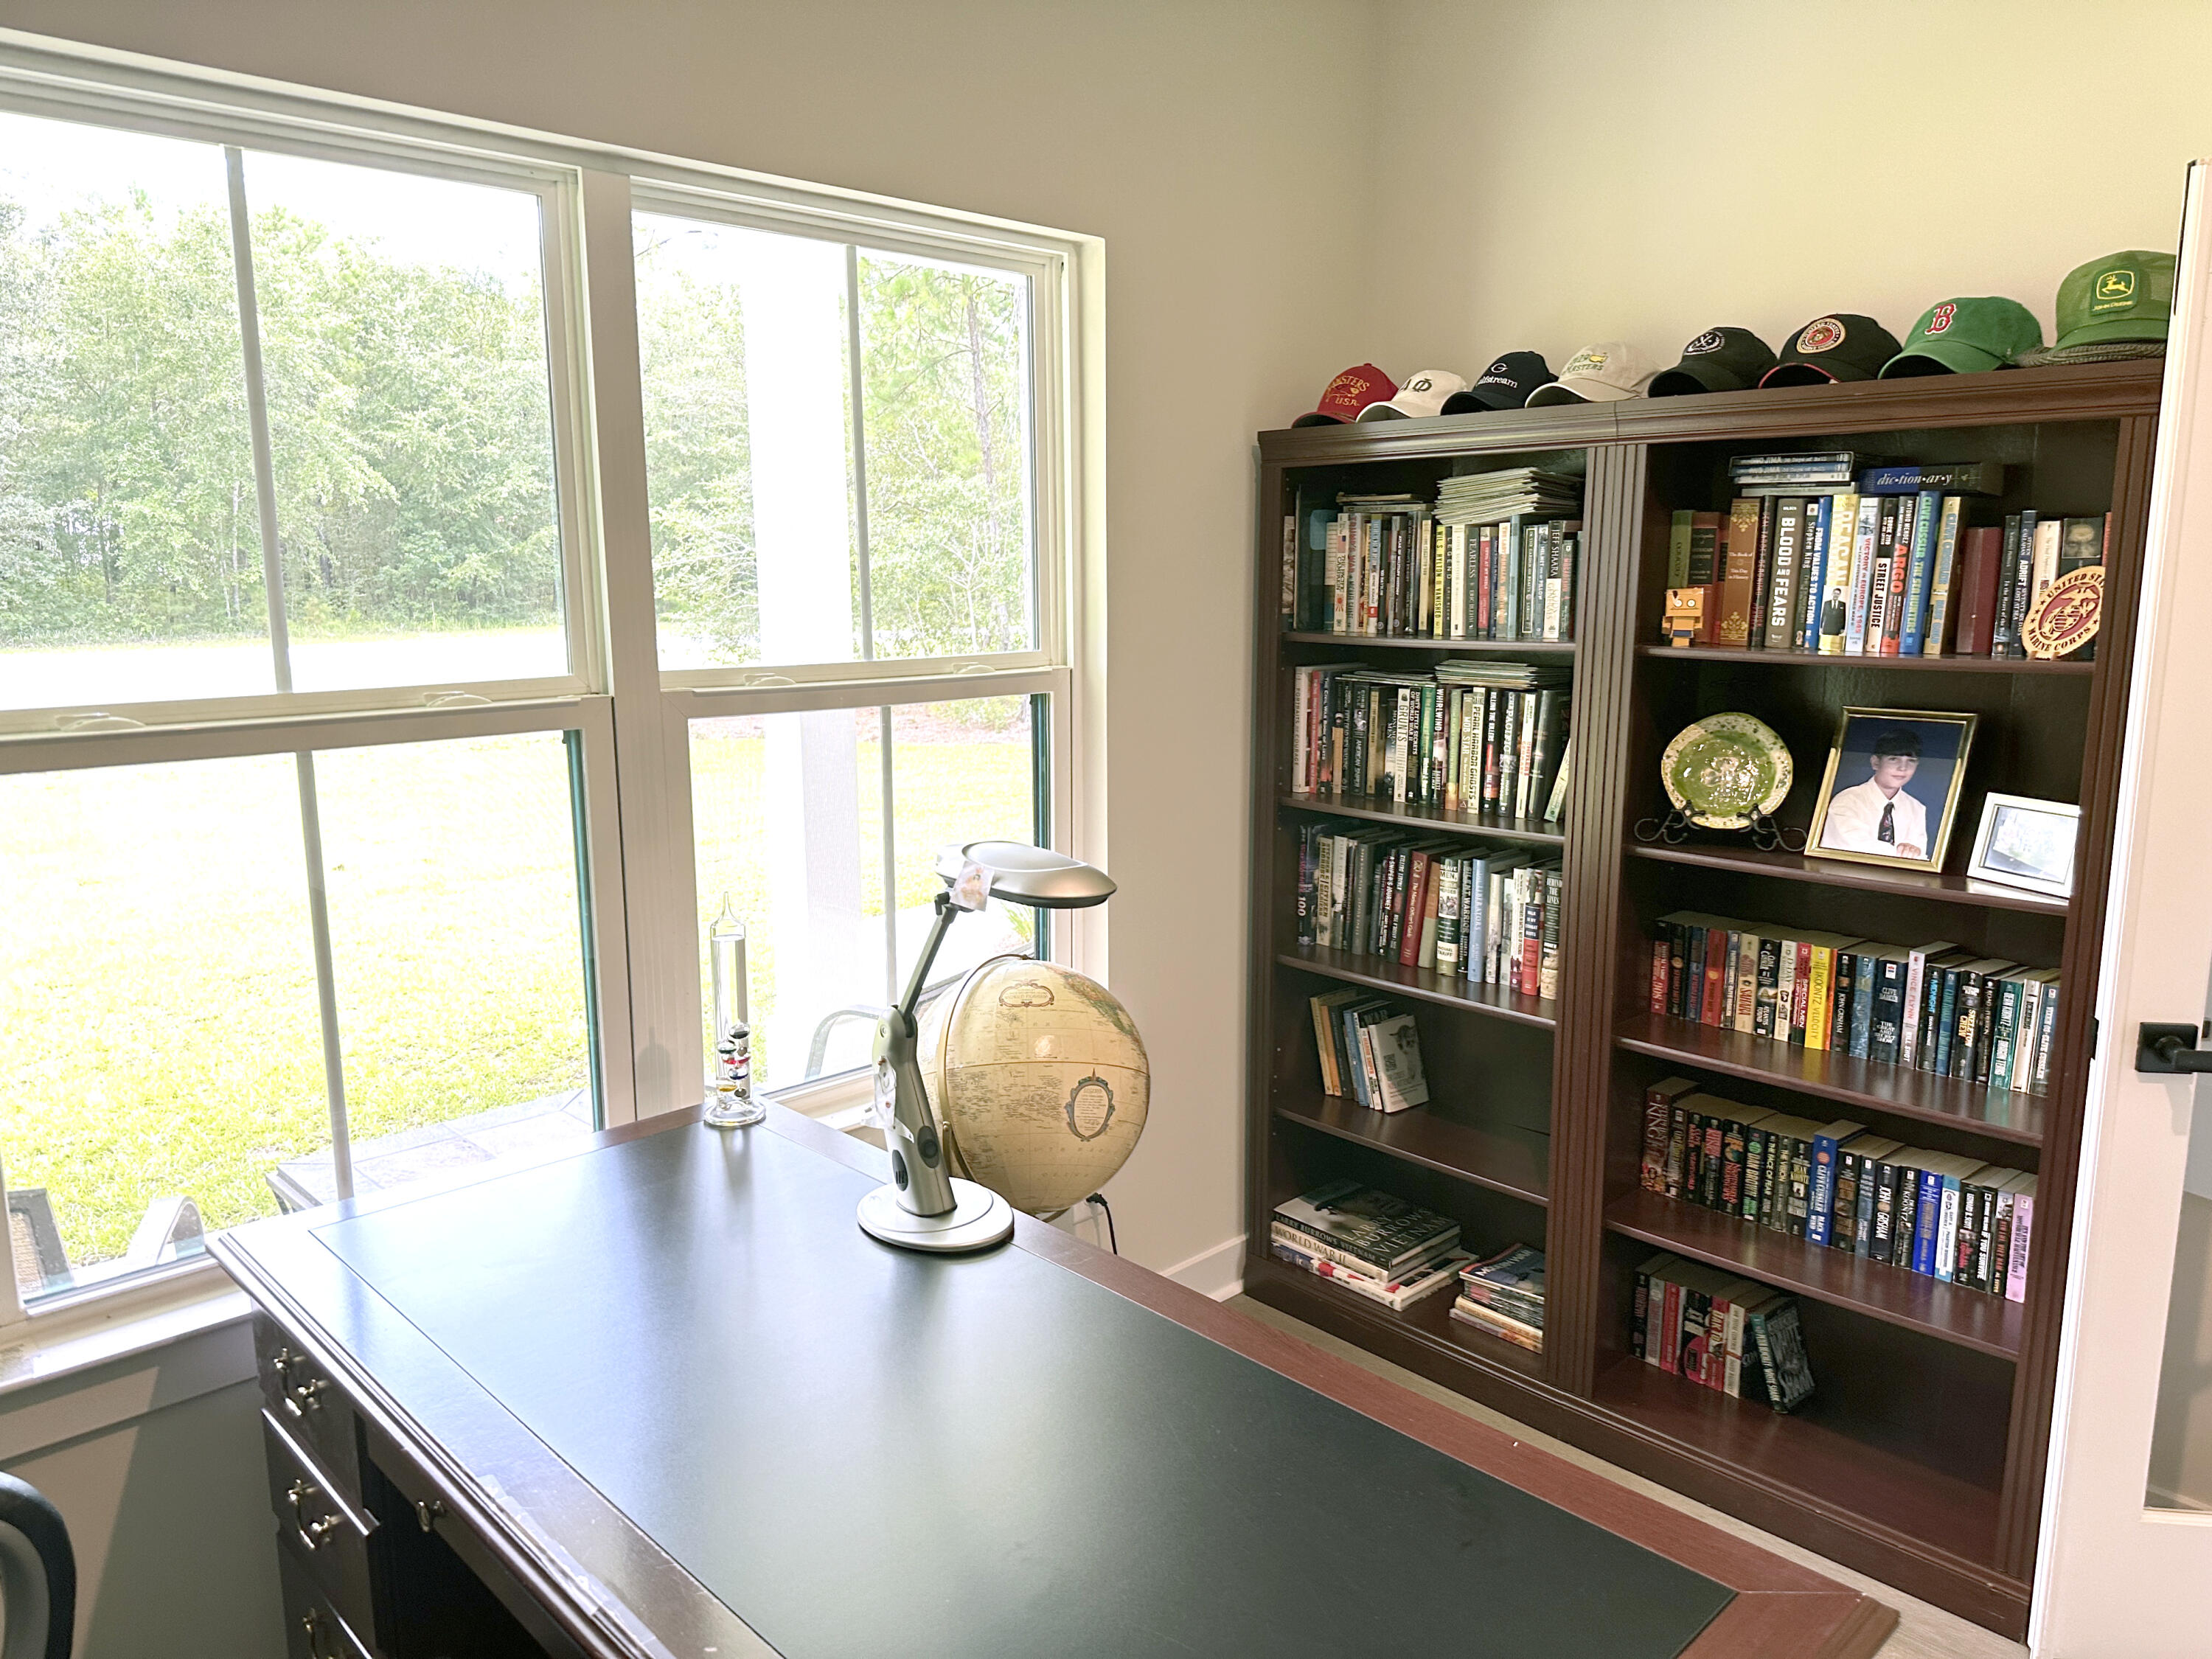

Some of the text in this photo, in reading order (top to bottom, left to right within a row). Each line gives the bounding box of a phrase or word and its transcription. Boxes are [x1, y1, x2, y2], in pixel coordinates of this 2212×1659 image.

[1924, 303, 1956, 335] B
[1475, 375, 1518, 389] ulfstream
[1491, 363, 1509, 373] G
[1335, 397, 1357, 406] USA
[1349, 515, 1357, 552] TRUMP'S
[1436, 531, 1444, 541] WIL
[1805, 521, 1815, 549] Stephen
[1902, 500, 1913, 544] ANTONIO MENDEZ
[1469, 538, 1477, 578] FEARLESS
[1551, 529, 1561, 577] JEFF SHAARA
[1802, 552, 1813, 568] King
[1828, 510, 1854, 582] REAGAN
[1863, 538, 1871, 571] VICTORY
[1348, 554, 1356, 574] WAR
[1771, 518, 1795, 626] BLOOD FEARS
[1806, 527, 1823, 625] FROM VALUES TO ACTION
[1890, 543, 1907, 594] ARGO
[1906, 496, 1932, 633] CLIVE CUSSLER THE SEA HUNTERS
[1931, 513, 1957, 644] CLIVE CUSSLER GOLD
[2017, 560, 2028, 586] ADRIFT
[1871, 563, 1888, 628] STREET JUSTICE
[2047, 573, 2087, 598] UNITED
[2028, 627, 2091, 651] MARINE CORPS
[1435, 688, 1444, 731] WHIRLWIND
[1489, 692, 1497, 711] KILLING
[1397, 705, 1408, 742] GRUNTS
[1462, 715, 1471, 754] MOB STAR
[1487, 722, 1495, 742] KILLERS
[1503, 709, 1514, 752] PACIFIC
[1469, 706, 1481, 800] PEARL HARBOR GHOSTS
[1384, 860, 1394, 911] SNIPER'S JOURNEY
[1546, 877, 1562, 888] BEHIND
[1549, 886, 1557, 896] THE
[1297, 896, 1307, 917] 100
[1462, 897, 1471, 933] WARRIOR
[1475, 886, 1483, 931] LIBERATORS
[1546, 894, 1560, 905] LINES
[1800, 979, 1809, 1008] SPECIAL
[1909, 968, 1918, 992] VINCE
[1738, 987, 1753, 1015] SAHARA
[1810, 974, 1825, 1040] KOONTZ VELOCITY
[1907, 995, 1916, 1019] FLYNN
[1927, 979, 1938, 1014] MIDNIGHT
[2000, 992, 2015, 1026] DEAN KOONTZ
[1835, 992, 1846, 1033] JOHN GRISHAM
[1958, 1015, 1968, 1037] CREW
[1964, 1009, 1976, 1048] SKELETON
[1994, 1060, 2007, 1076] TEARS
[2037, 1034, 2051, 1079] CLIVE CUSSLER
[1646, 1102, 1664, 1139] KING
[1704, 1128, 1715, 1155] KING
[1747, 1152, 1759, 1169] DAN
[1766, 1154, 1775, 1170] FACE
[1766, 1171, 1774, 1180] OF
[1743, 1169, 1758, 1197] BROWN
[1764, 1180, 1773, 1195] FEAR
[1815, 1165, 1826, 1212] CLIVE CUSSLER
[1875, 1186, 1891, 1239] JOHN GRISHAM
[1901, 1191, 1910, 1222] KOONTZ
[1300, 1223, 1338, 1246] BURROWS
[1341, 1214, 1393, 1242] LARRY
[1355, 1206, 1433, 1248] BURROWS
[1373, 1216, 1451, 1253] VIETNAM
[1817, 1215, 1825, 1232] BLACK
[1274, 1224, 1348, 1265] WORLD WAR II
[1977, 1253, 1986, 1281] SURVIVE
[1766, 1384, 1781, 1402] SHARK
